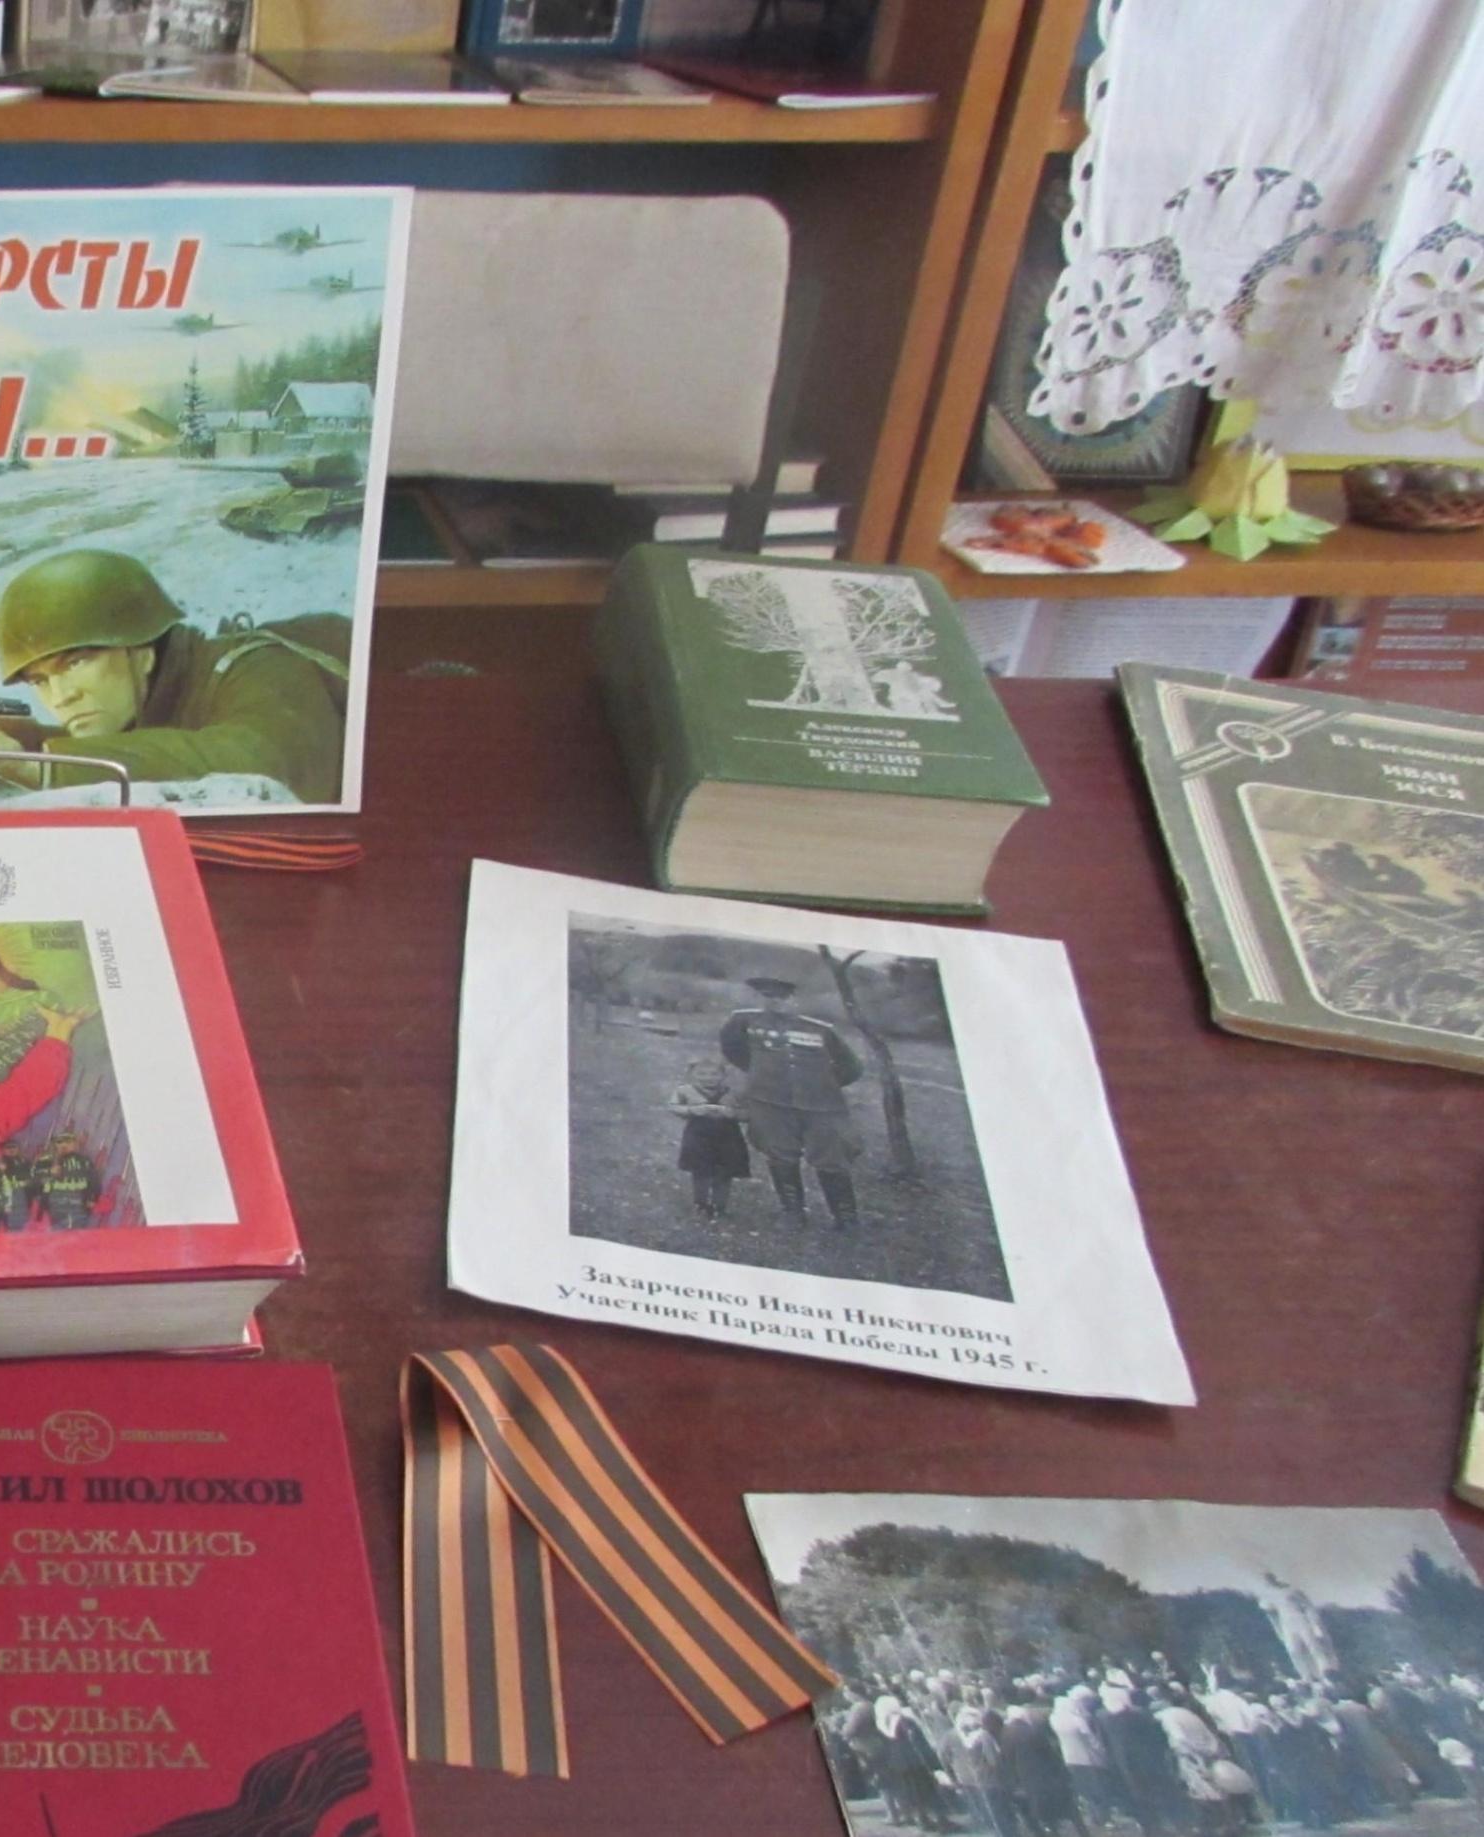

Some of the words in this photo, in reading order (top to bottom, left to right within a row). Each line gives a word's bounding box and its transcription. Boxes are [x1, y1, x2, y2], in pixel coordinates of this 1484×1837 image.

[809, 749, 922, 765] ВАСИЛИЙ
[1381, 764, 1460, 785] ИВАН
[580, 1264, 748, 1308] Захарченко
[758, 1294, 833, 1320] Иван
[844, 1308, 1012, 1347] Никитович
[556, 1283, 699, 1322] Участник
[708, 1309, 815, 1340] Парада
[825, 1328, 940, 1360] Победы
[951, 1346, 1015, 1370] 1945
[1026, 1361, 1050, 1375] г.
[84, 1476, 303, 1505] ШОЛОХОВ
[13, 1530, 256, 1557] СРАЖАЛИСЬ
[39, 1562, 205, 1590] РОДИНУ
[18, 1616, 166, 1643] НАУКА
[10, 1706, 176, 1738] СУДЬБА
